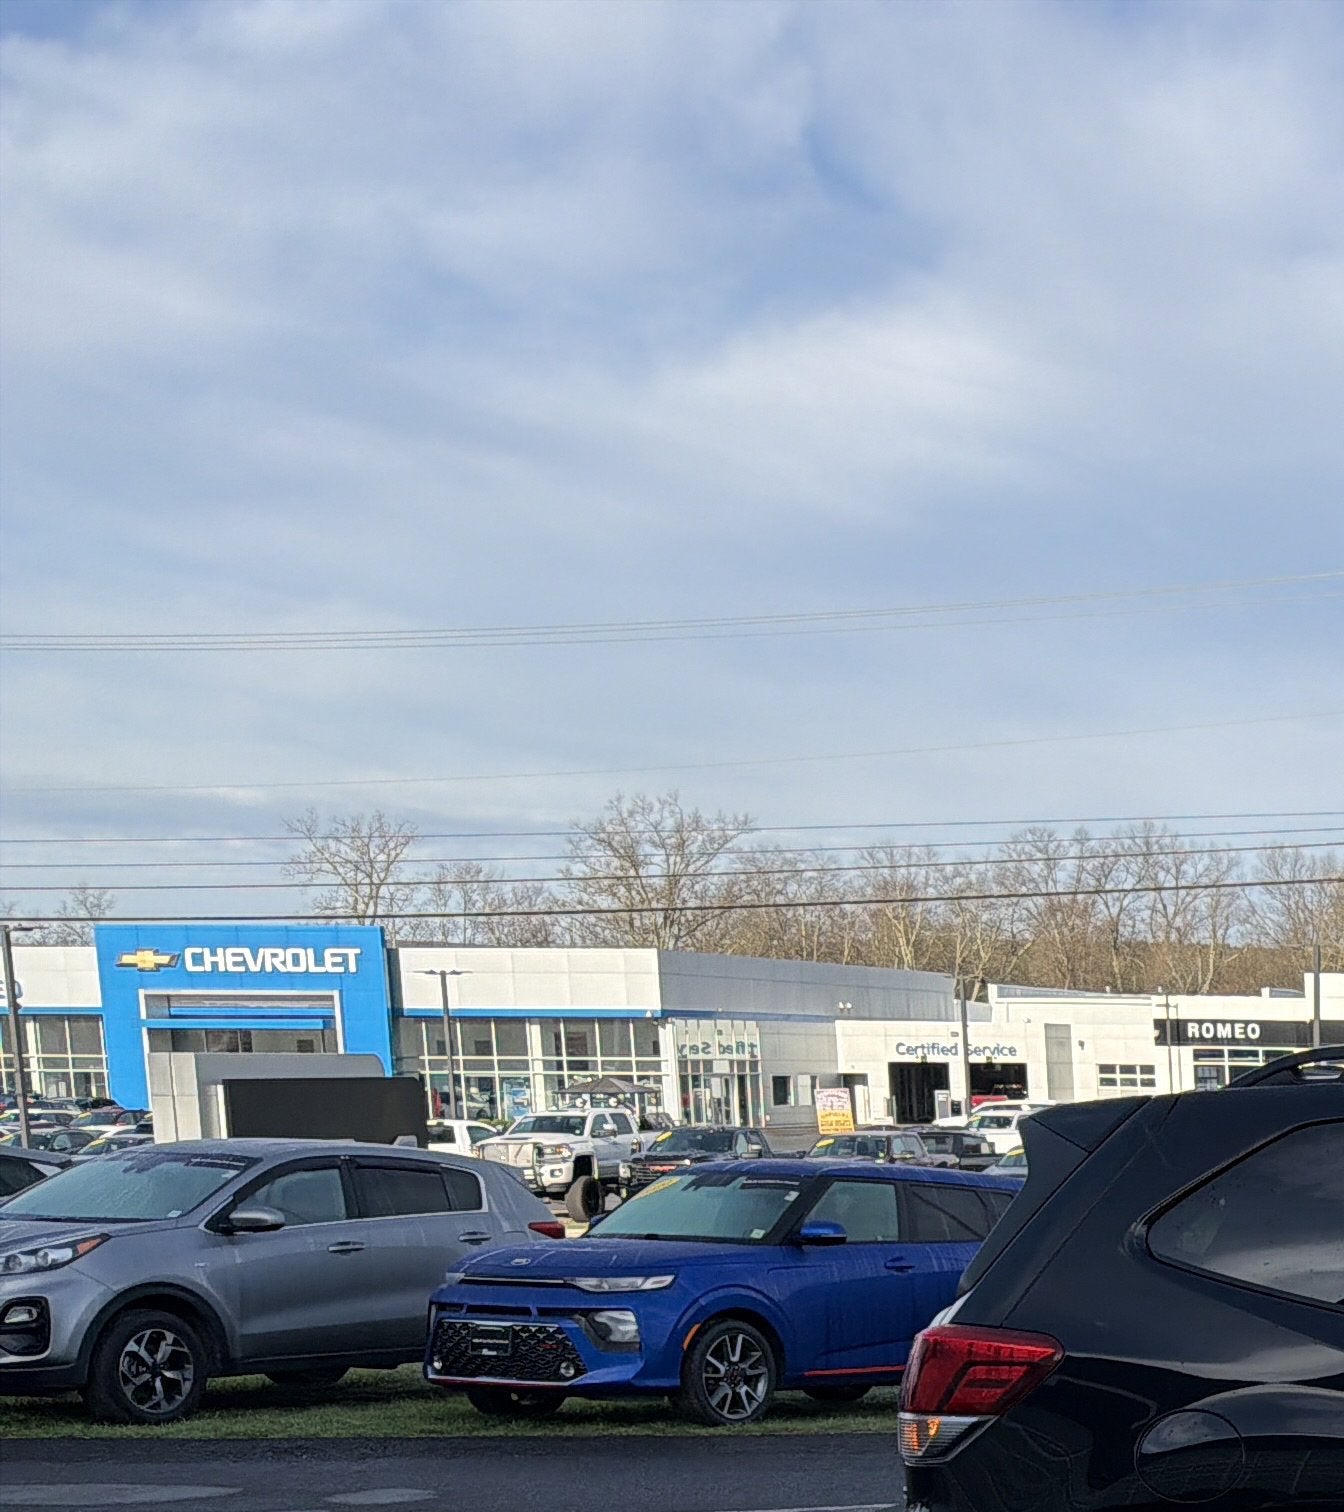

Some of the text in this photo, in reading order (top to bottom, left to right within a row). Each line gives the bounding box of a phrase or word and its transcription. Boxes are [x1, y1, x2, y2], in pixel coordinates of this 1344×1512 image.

[184, 947, 360, 972] CHEVROLET
[1187, 1022, 1261, 1040] ROMEO
[895, 1042, 1017, 1056] Certified Service
